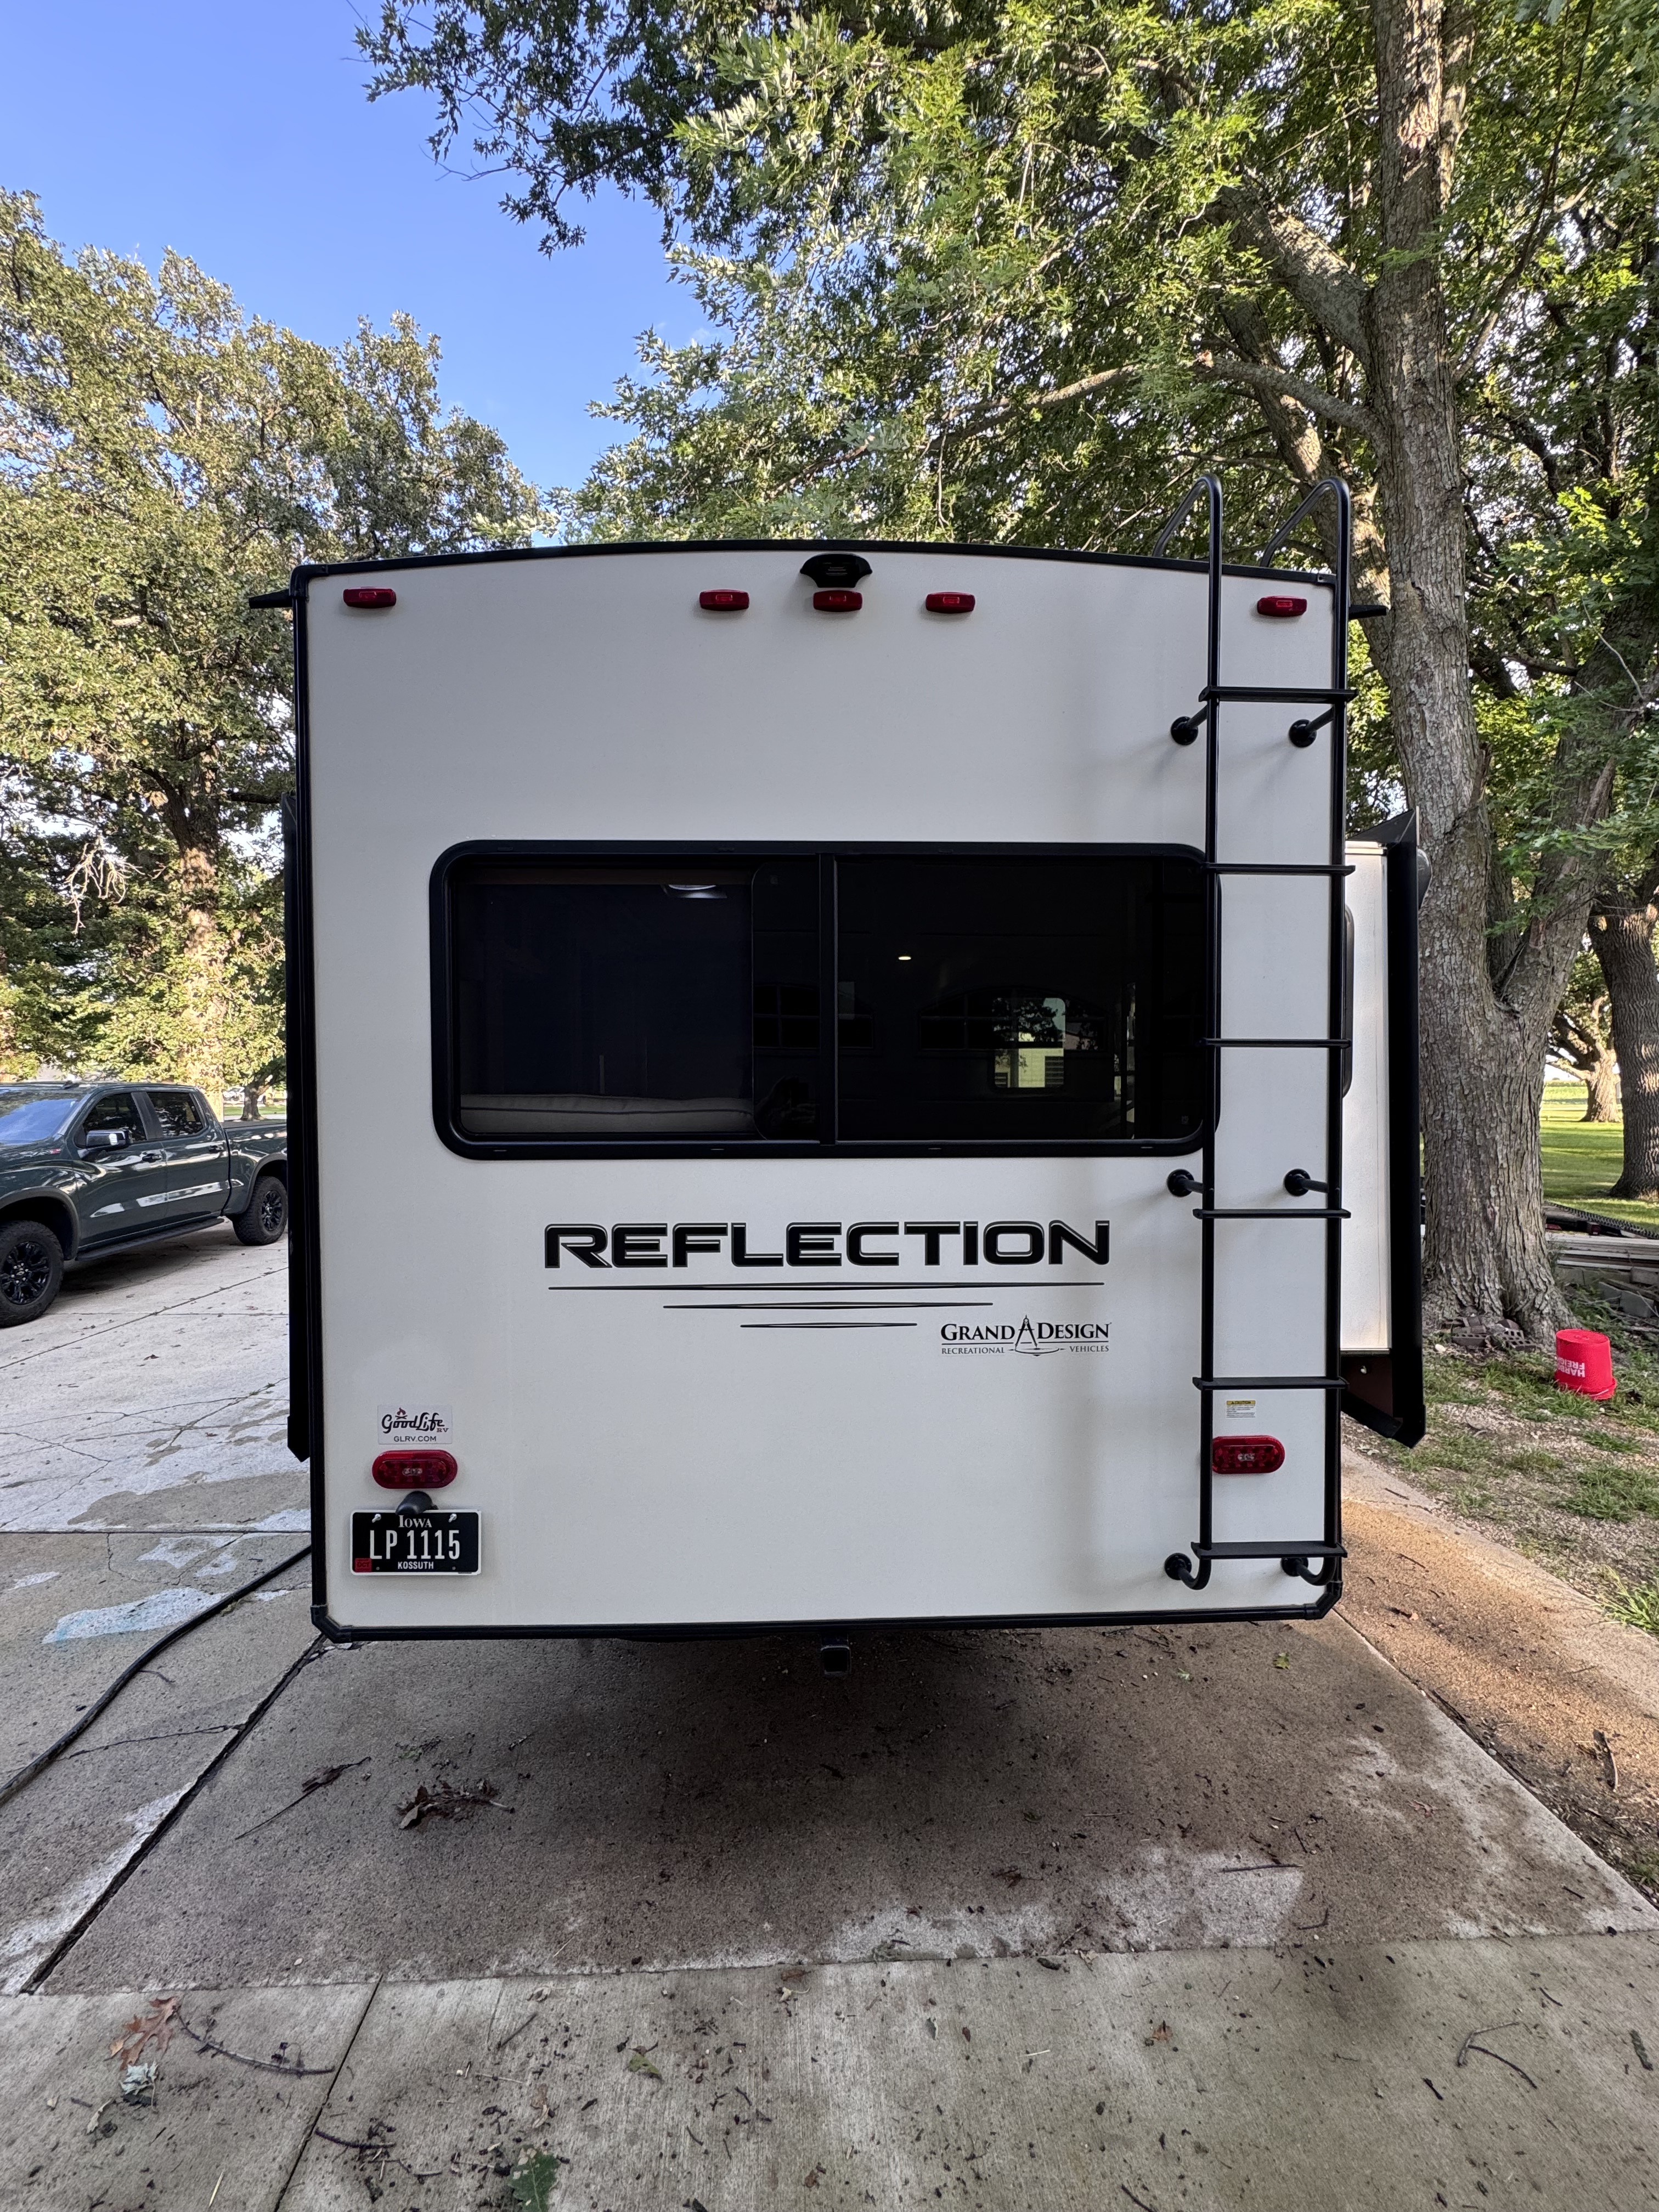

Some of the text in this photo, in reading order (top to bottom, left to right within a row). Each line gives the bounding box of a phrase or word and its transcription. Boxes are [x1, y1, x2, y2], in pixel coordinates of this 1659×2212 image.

[544, 1220, 1110, 1268] REFLECTION
[940, 1322, 1109, 1341] GRAND DESIGN
[398, 1515, 432, 1528] IOWA
[370, 1530, 460, 1560] LP 1115
[397, 1561, 434, 1570] KOSSUTH
